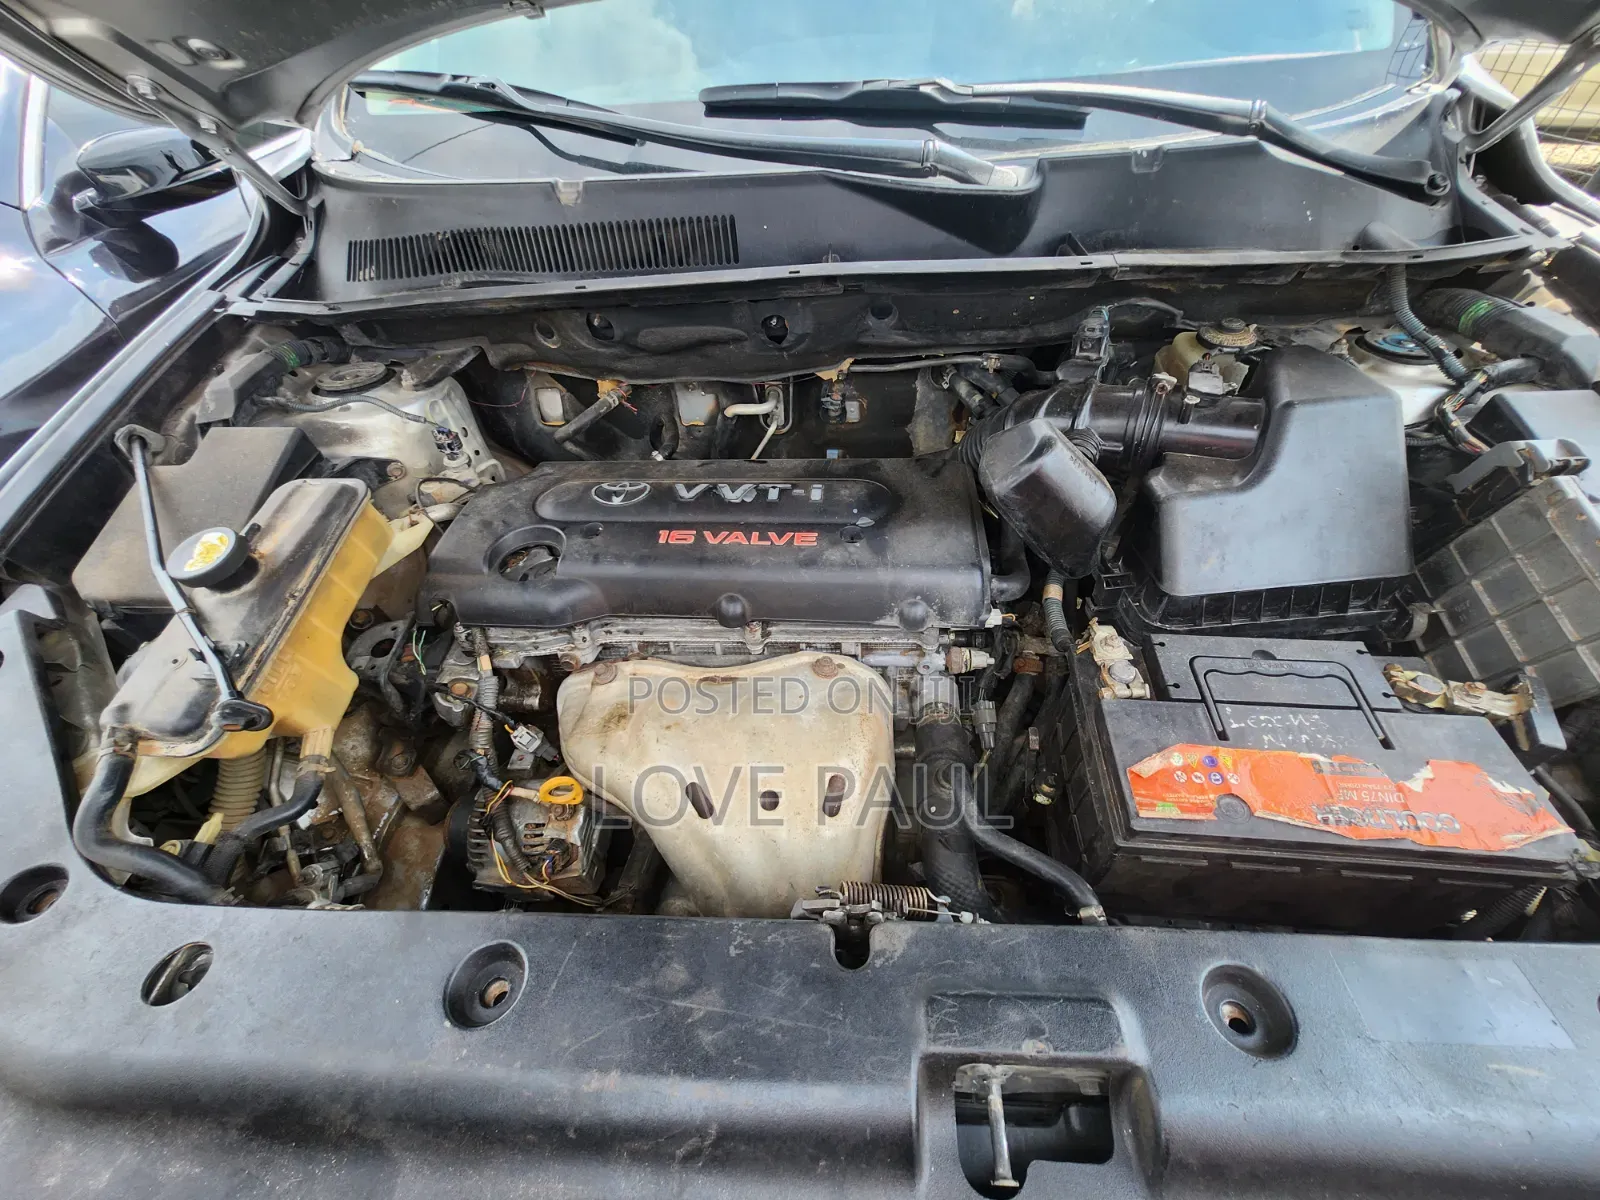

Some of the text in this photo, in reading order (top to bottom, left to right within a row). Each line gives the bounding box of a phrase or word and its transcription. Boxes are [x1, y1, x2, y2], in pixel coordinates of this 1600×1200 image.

[674, 483, 824, 503] VVT-i
[658, 529, 819, 546] 16 VALVE
[1361, 790, 1405, 804] DIN75
